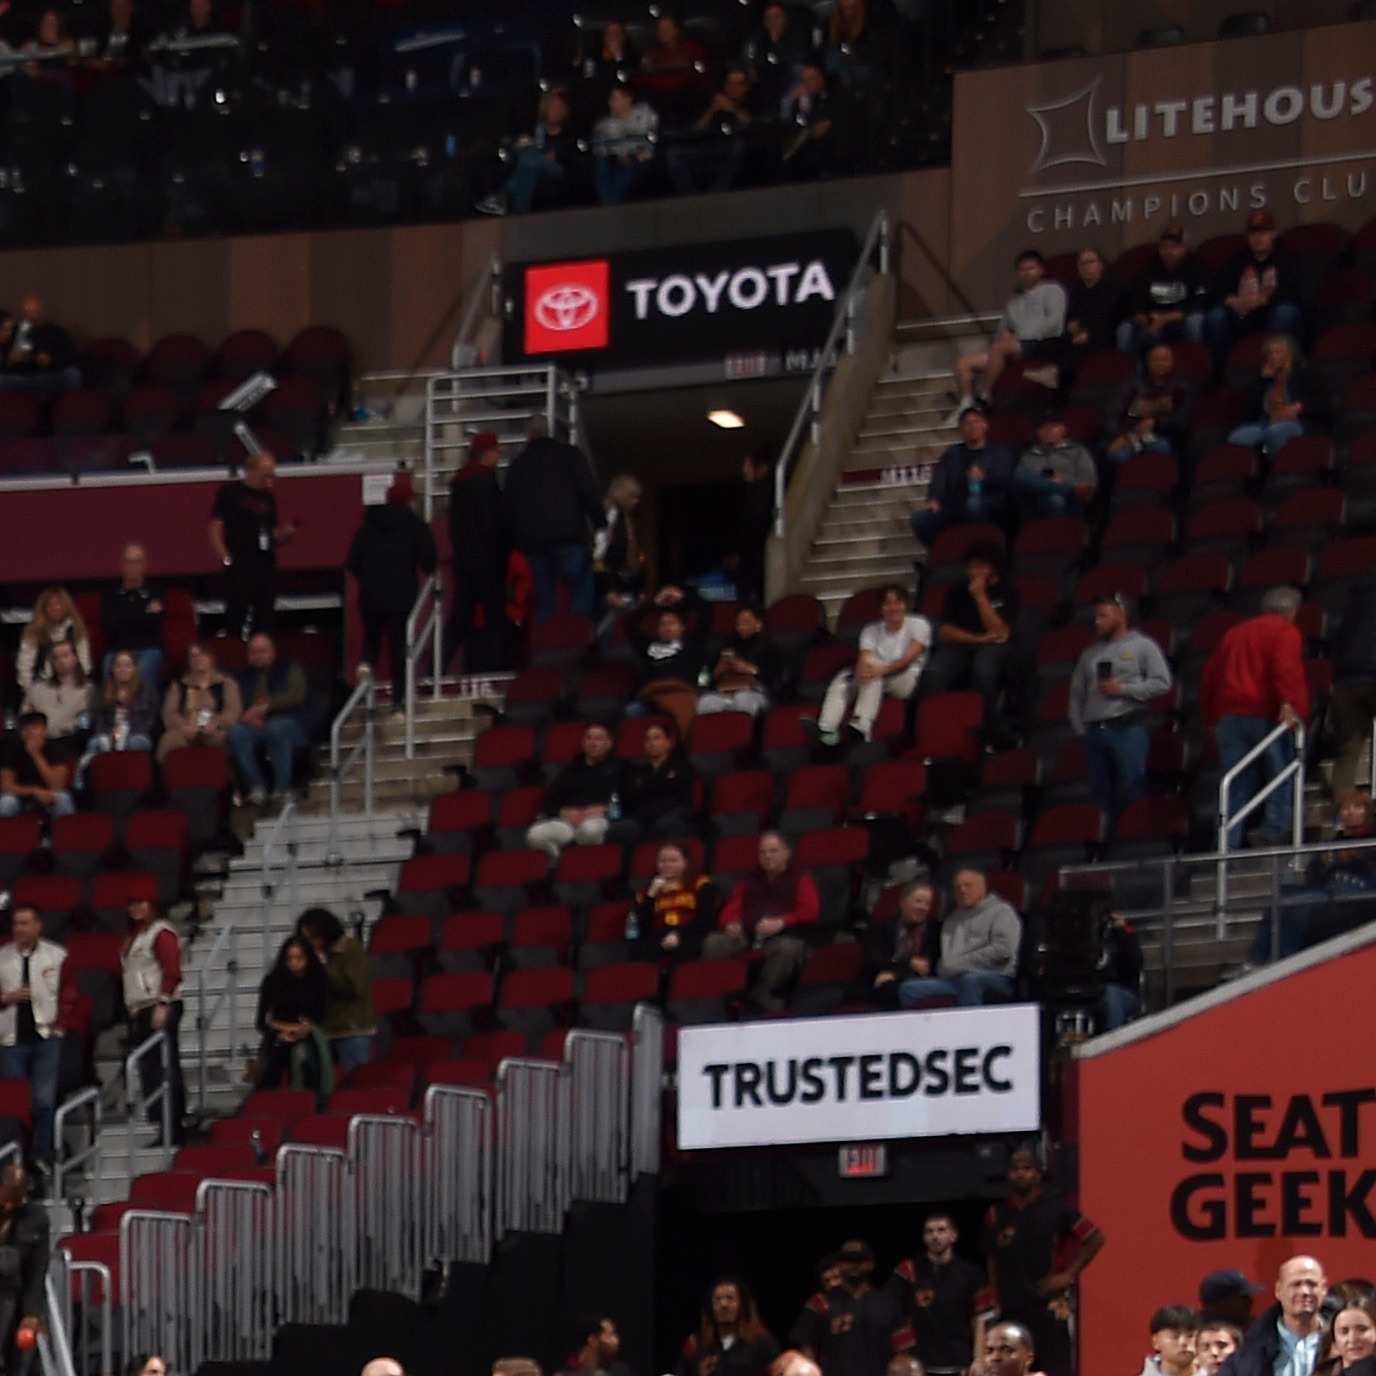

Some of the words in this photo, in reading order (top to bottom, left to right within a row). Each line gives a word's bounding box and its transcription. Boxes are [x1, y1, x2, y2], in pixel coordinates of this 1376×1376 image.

[1026, 185, 1267, 234] CHAMPIONS
[1293, 171, 1367, 204] CLU
[625, 259, 835, 320] TOYOTA
[703, 1045, 1014, 1110] TRUSTEDSEC
[1181, 1088, 1376, 1164] SEAT
[1170, 1170, 1376, 1243] GEEK
